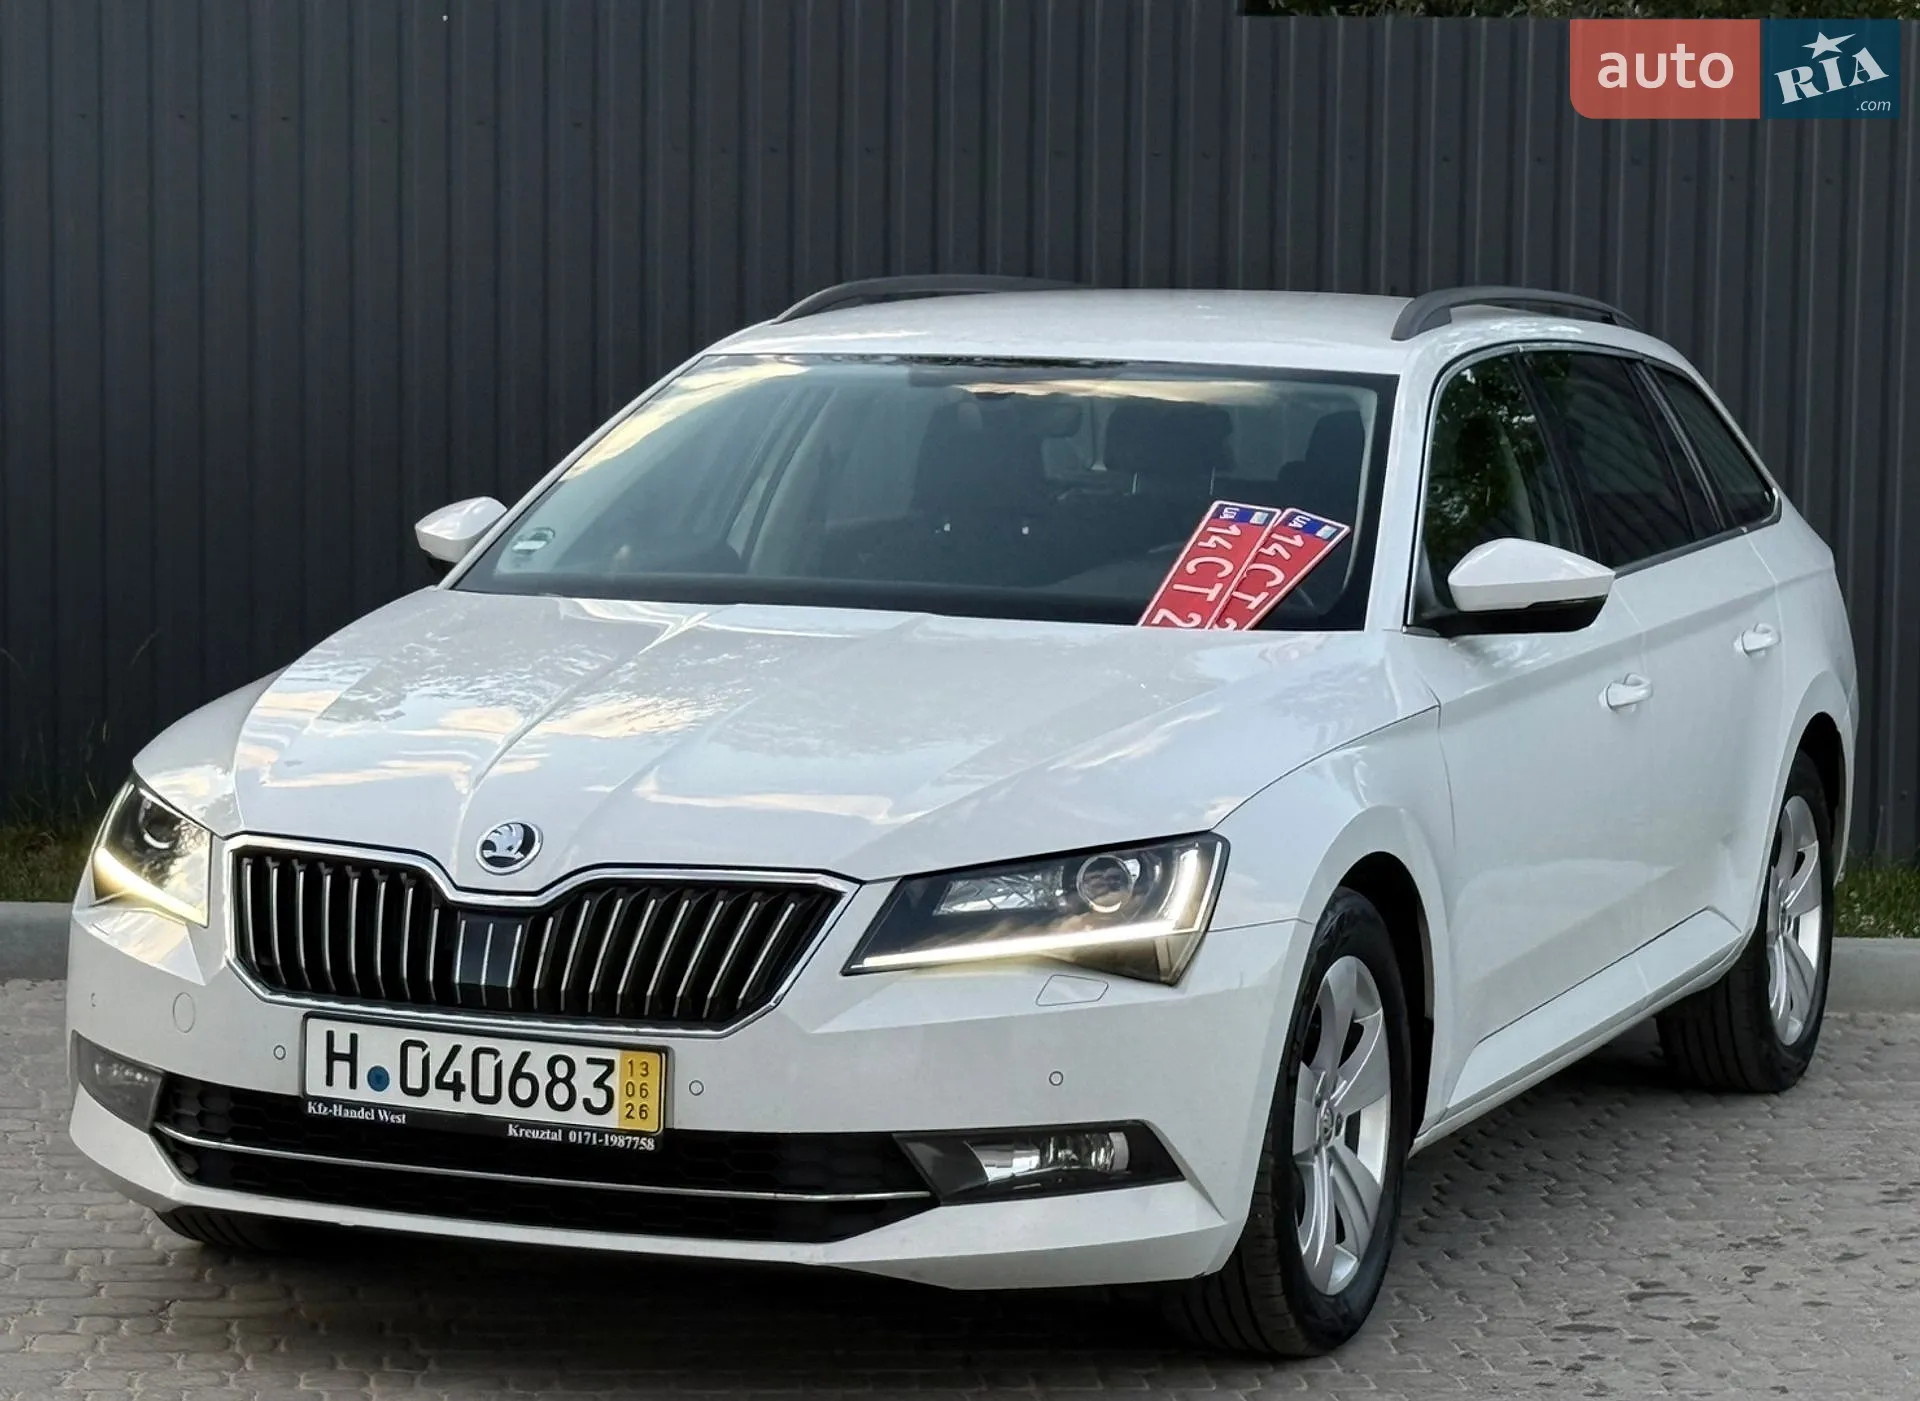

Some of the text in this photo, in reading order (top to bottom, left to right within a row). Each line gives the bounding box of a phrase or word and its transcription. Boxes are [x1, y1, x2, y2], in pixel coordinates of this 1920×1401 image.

[1219, 507, 1240, 520] UA
[1288, 514, 1310, 528] UA
[325, 1029, 616, 1117] H 040683
[627, 1058, 649, 1078] 13
[625, 1081, 649, 1099] 06
[307, 1101, 406, 1124] Kfz-Handel West
[625, 1103, 649, 1121] 26
[507, 1123, 656, 1151] Kreuztal 0171-1987758
